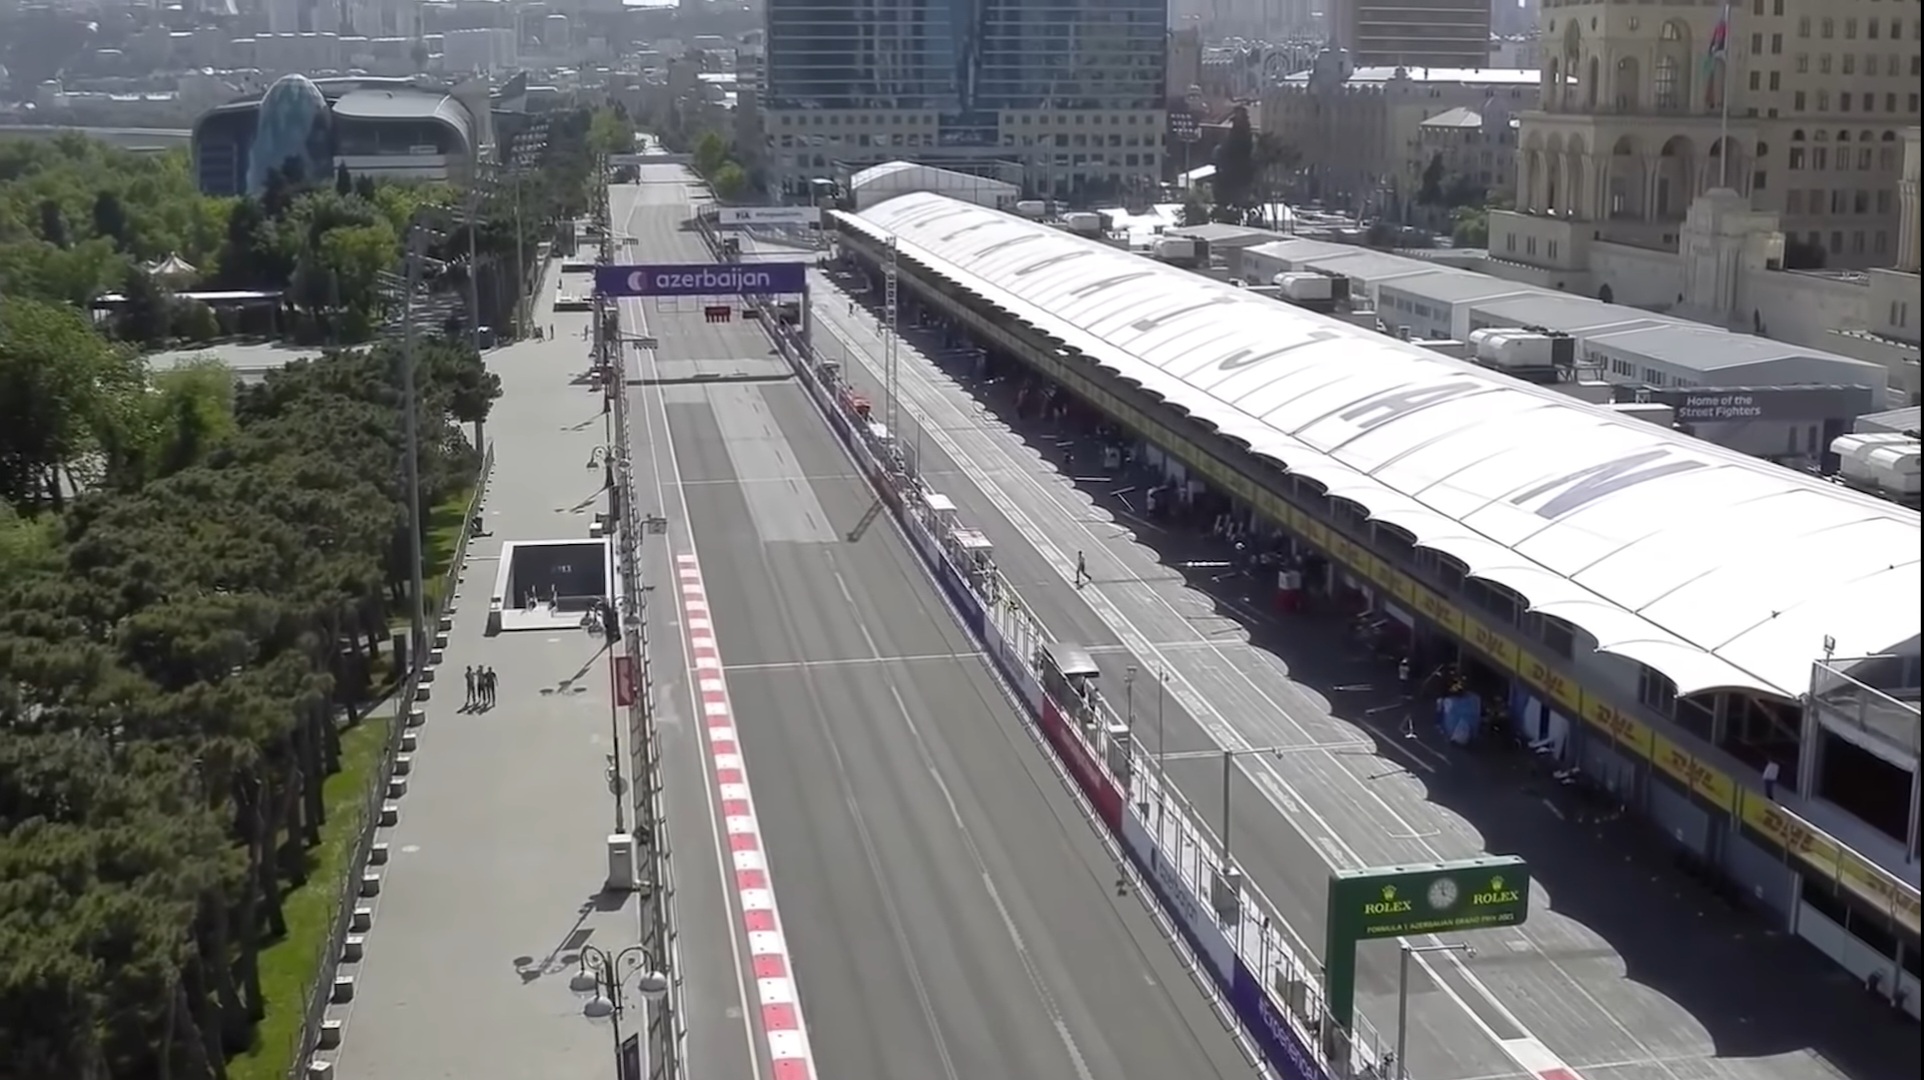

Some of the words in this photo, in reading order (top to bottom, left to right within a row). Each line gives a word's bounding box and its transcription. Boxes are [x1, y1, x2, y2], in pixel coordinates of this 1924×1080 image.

[656, 268, 770, 291] azerbaijan
[1686, 396, 1719, 407] Home
[1720, 396, 1732, 406] of
[1734, 395, 1752, 406] the
[1679, 407, 1714, 418] Street
[1715, 406, 1761, 418] Fighters
[1473, 890, 1519, 905] ROLEX
[1364, 900, 1412, 915] ROLEX
